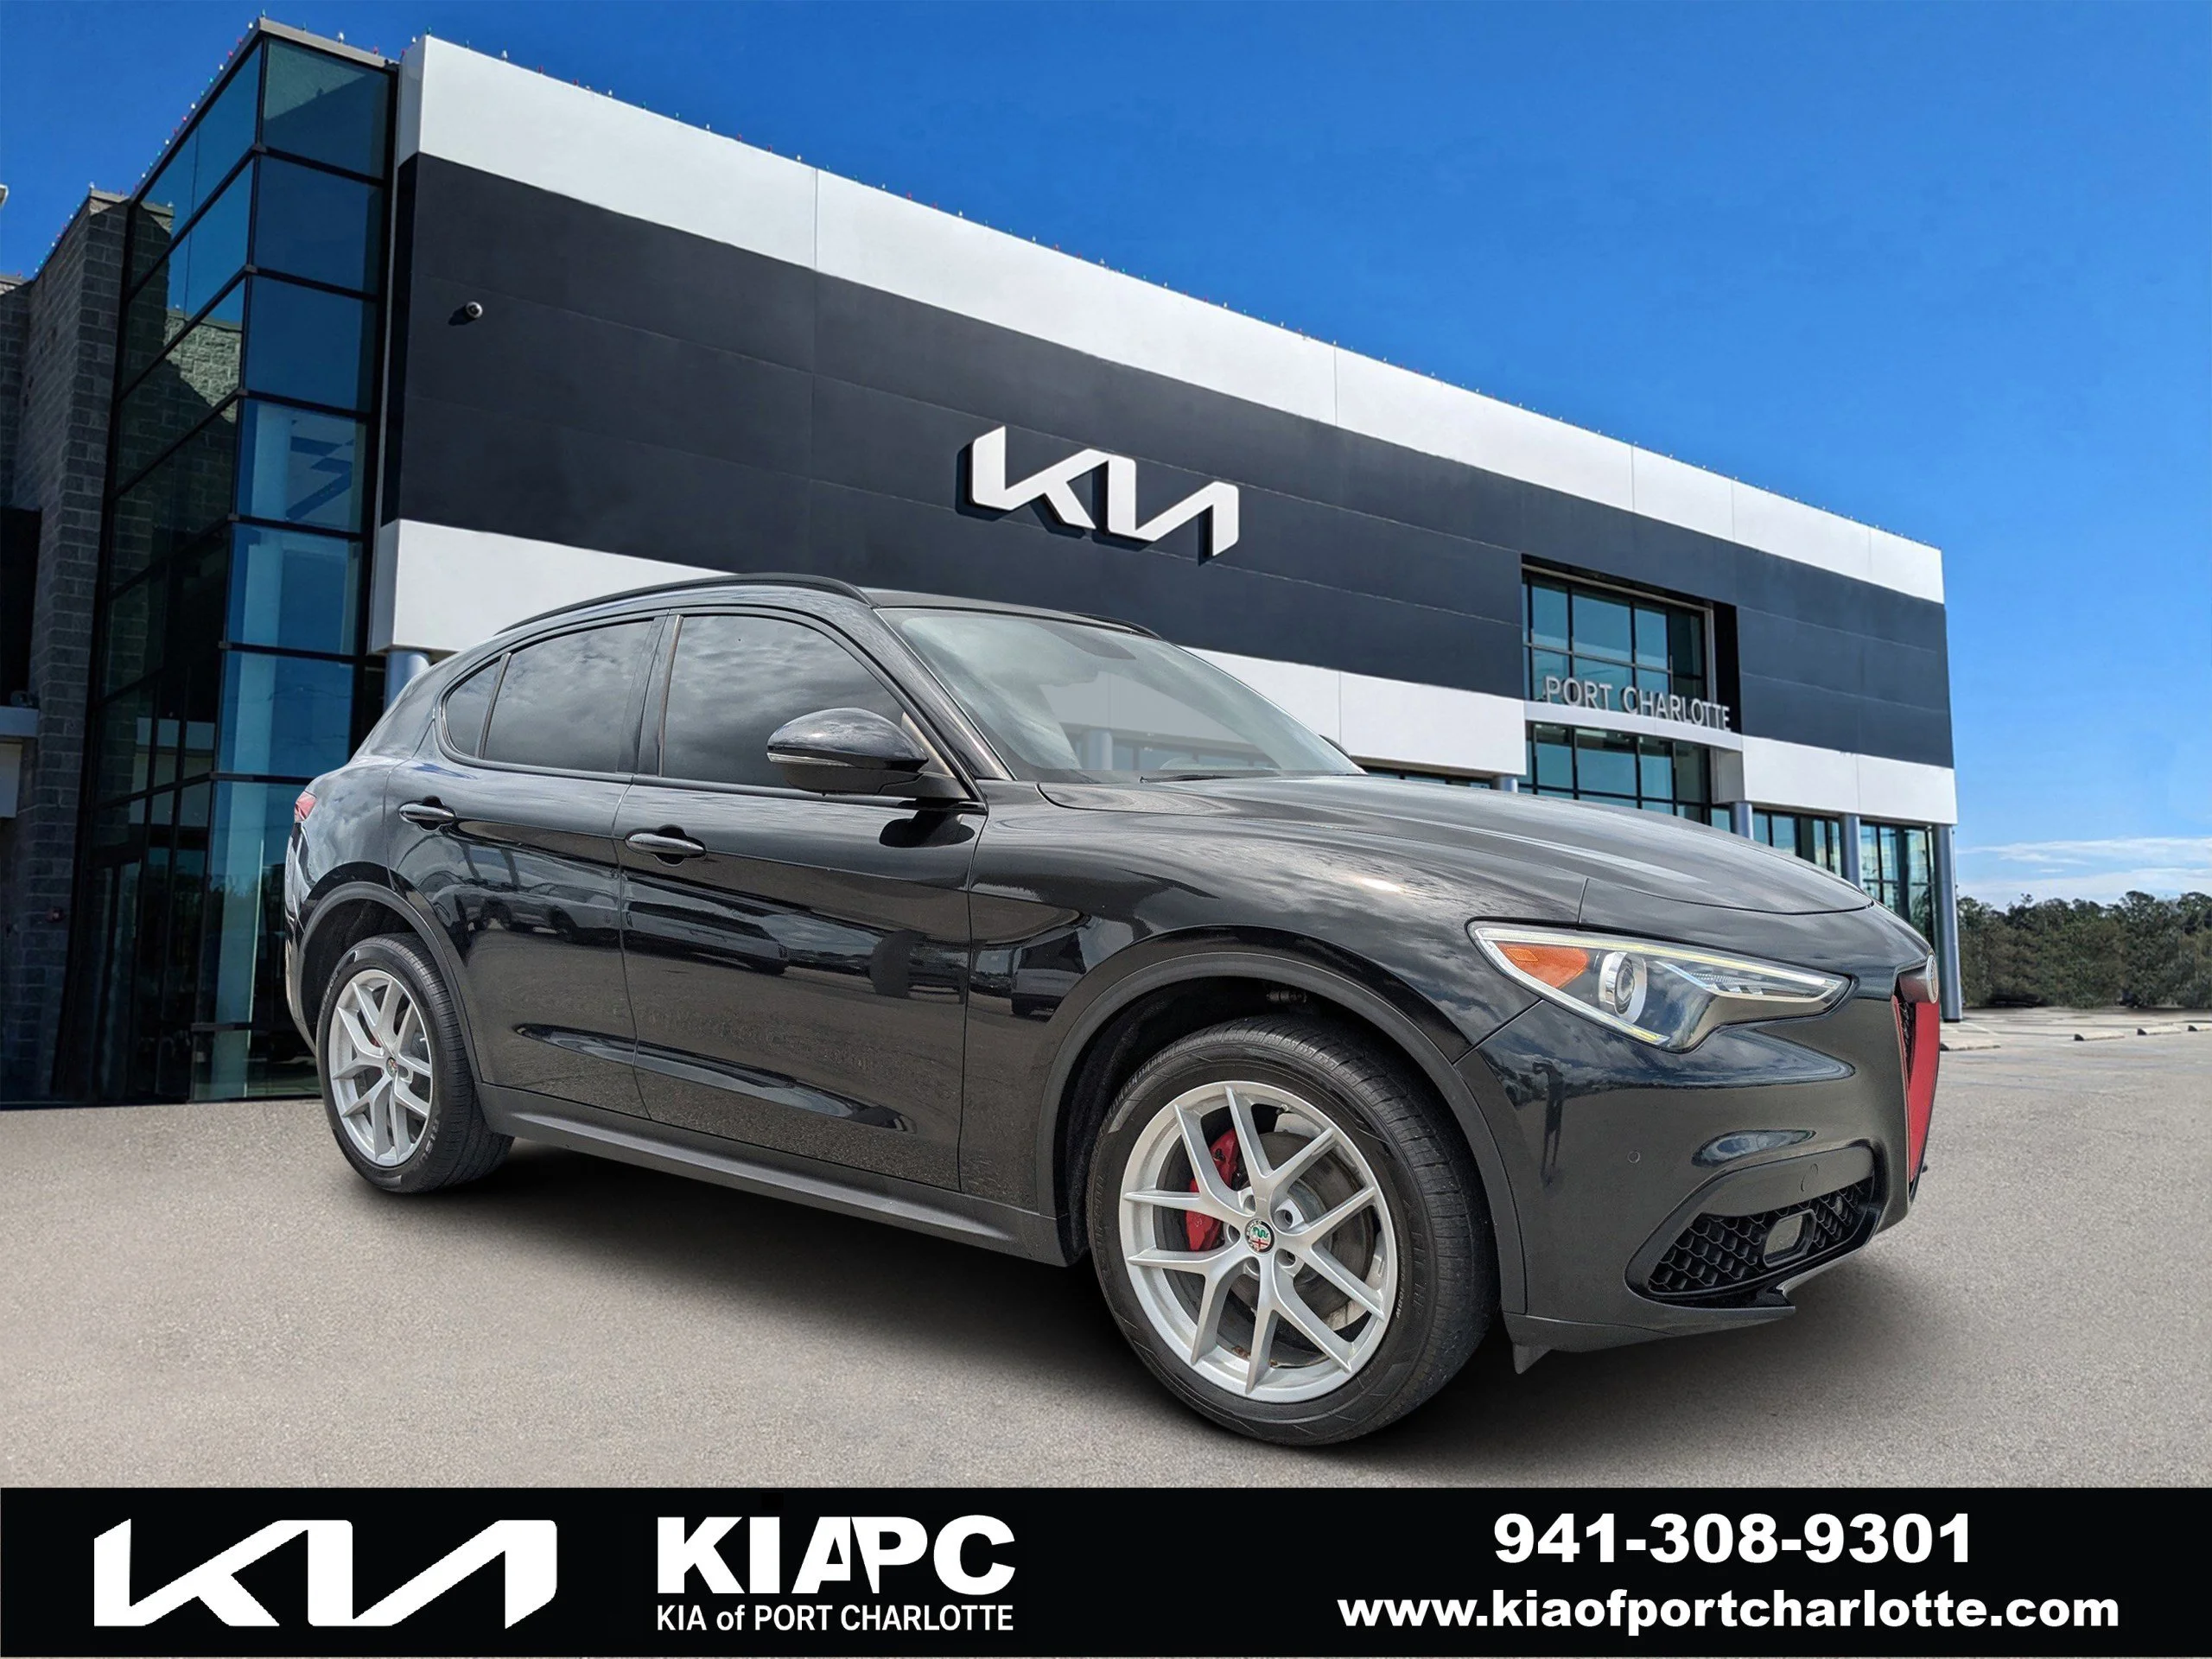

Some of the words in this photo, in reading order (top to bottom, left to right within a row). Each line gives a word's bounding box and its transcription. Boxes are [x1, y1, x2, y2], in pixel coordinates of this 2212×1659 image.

[972, 425, 1239, 557] KIA
[1544, 675, 1613, 712] PORT
[1622, 686, 1732, 732] CHARLOTTE
